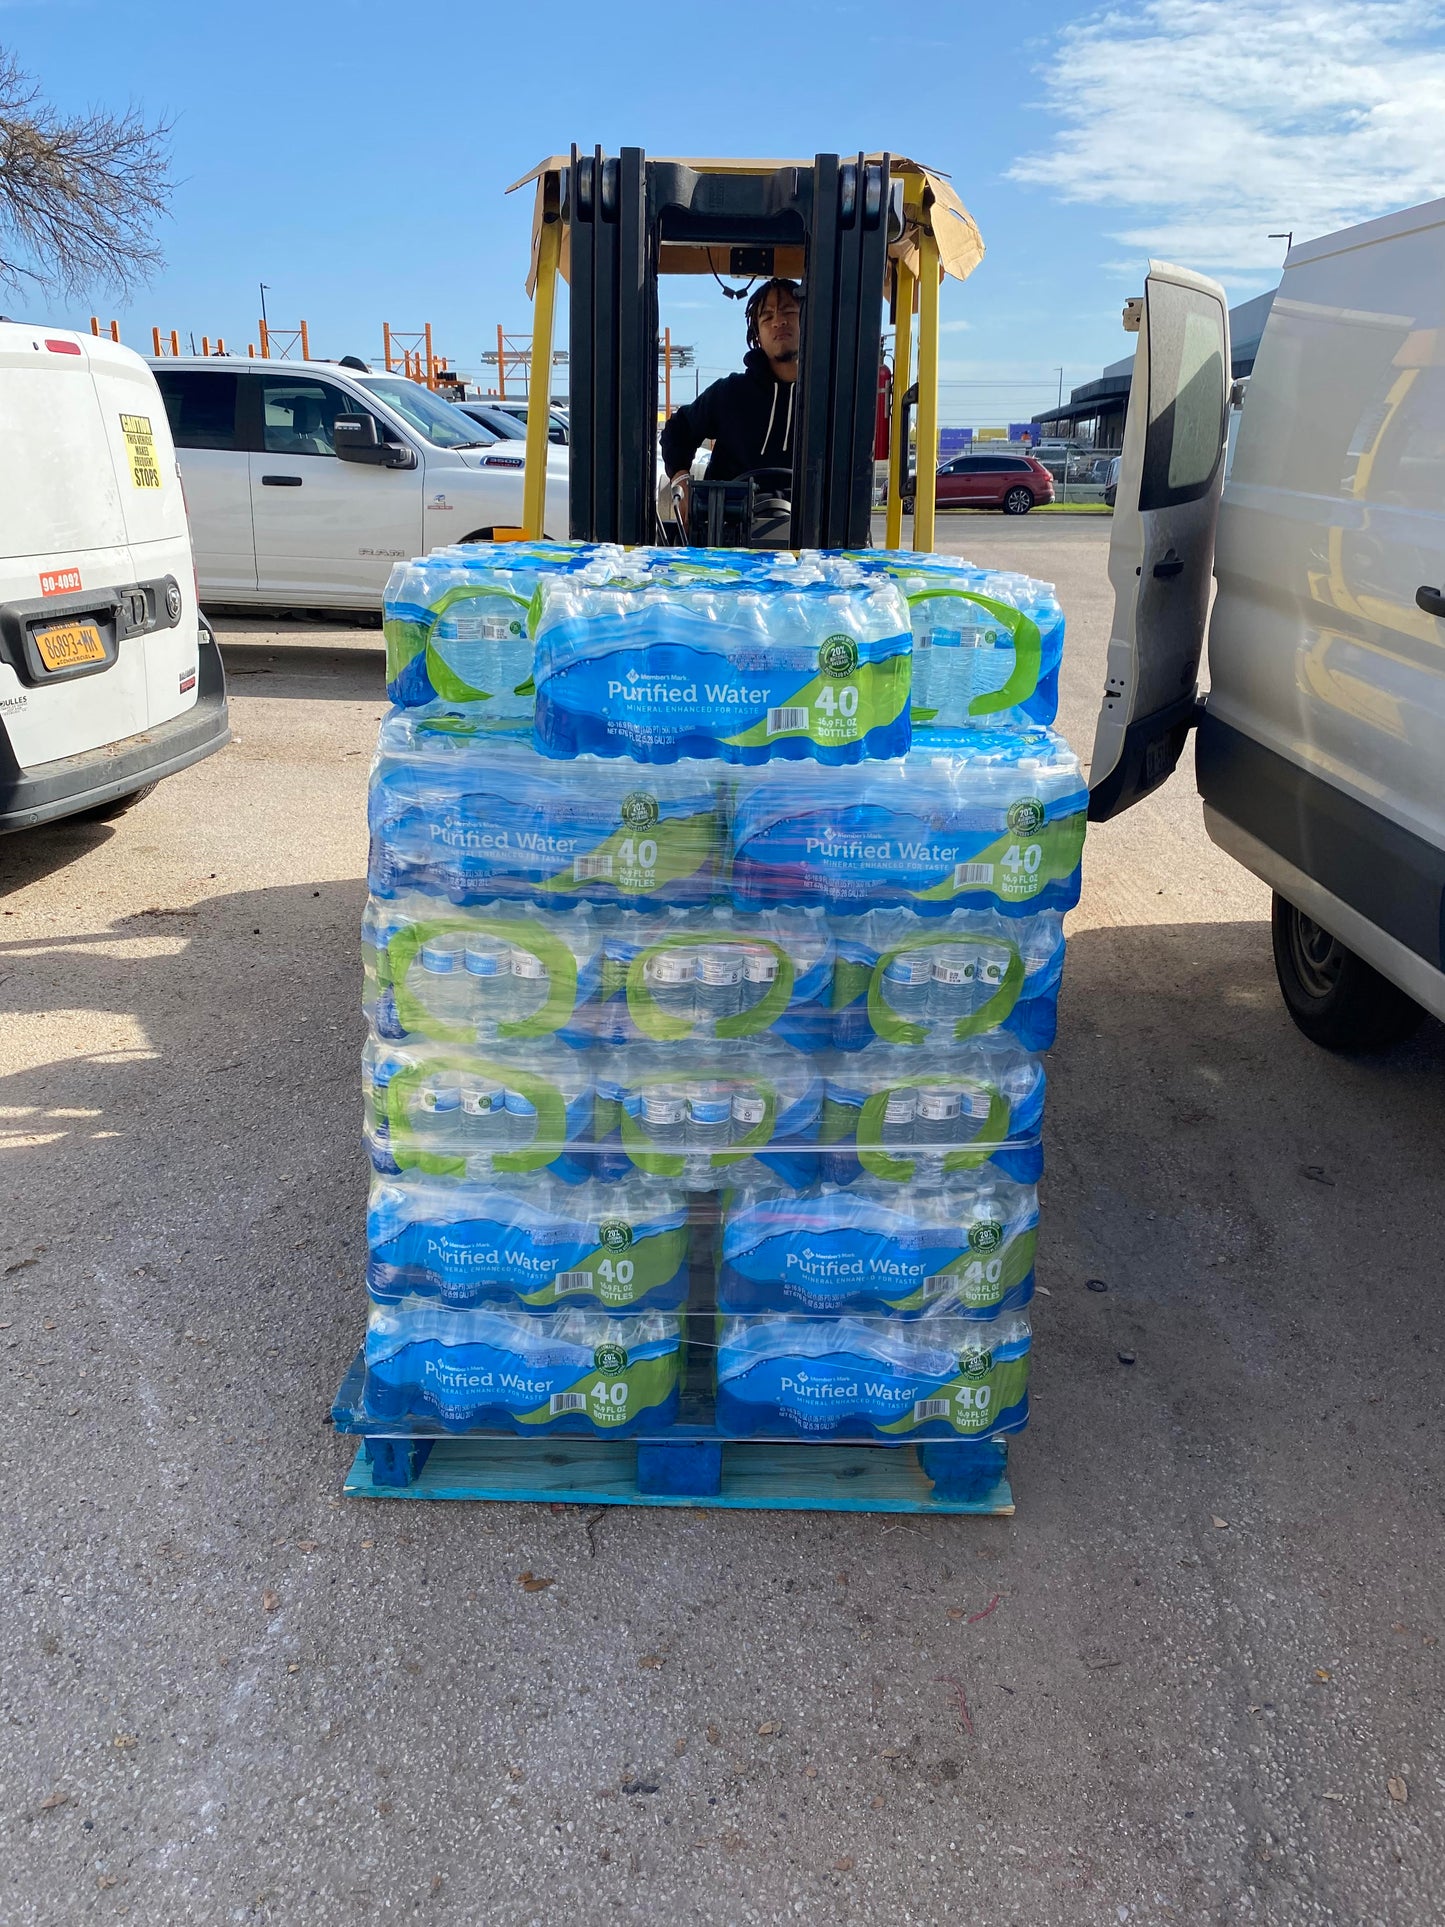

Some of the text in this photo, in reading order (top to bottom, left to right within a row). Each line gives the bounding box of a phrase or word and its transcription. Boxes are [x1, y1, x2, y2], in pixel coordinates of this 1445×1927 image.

[121, 414, 151, 434] CAUTION
[126, 434, 152, 446] THIS VEHICLE
[135, 446, 149, 456] MAKES
[134, 456, 153, 467] FREQUENT
[134, 467, 159, 487] STOPS
[359, 548, 404, 557] RAM
[42, 572, 80, 592] 90-4092
[830, 645, 846, 656] 20%
[640, 673, 670, 681] Member's
[608, 681, 771, 704] Purified Water
[815, 685, 859, 718] 40
[626, 704, 759, 715] MINERAL ENHANCED FOR TASTE
[817, 717, 857, 729] 16.9 FL OZ
[607, 727, 617, 735] NET
[818, 727, 858, 738] BOTTLES
[430, 824, 578, 853] Purified Water
[617, 838, 658, 869] 40
[806, 837, 959, 861] Purified Water
[823, 859, 857, 869] MINERAL
[860, 861, 904, 869] ENHANCED
[907, 862, 923, 870] FOR
[1000, 844, 1042, 874] 40
[644, 869, 656, 878] OZ
[1002, 873, 1039, 885] 16.9 FL OZ
[619, 874, 656, 888] BOTTLES
[1001, 882, 1038, 894] BOTTLES
[427, 1239, 559, 1272] Purified Water
[786, 1253, 926, 1276] Purified Water
[526, 1271, 547, 1280] TASTE
[597, 1258, 634, 1284] 40
[964, 1258, 1003, 1284] 40
[802, 1273, 916, 1285] MINERAL ENHANCD FOR TASTE
[613, 1284, 622, 1292] FL
[623, 1283, 633, 1292] OZ
[982, 1285, 991, 1293] FL
[600, 1288, 633, 1300] BOTTLES
[965, 1290, 1000, 1301] BOTTLES
[425, 1360, 554, 1393] Purified Water
[507, 1389, 520, 1397] FOR
[590, 1381, 628, 1406] 40
[780, 1377, 919, 1401] Purified Water
[797, 1397, 828, 1406] MINERAL
[872, 1399, 885, 1407] FOR
[954, 1385, 991, 1410] 40
[594, 1409, 627, 1421] BOTTLES
[957, 1409, 970, 1418] 16.9
[970, 1410, 980, 1418] FL
[956, 1416, 988, 1427] BOTTLES
